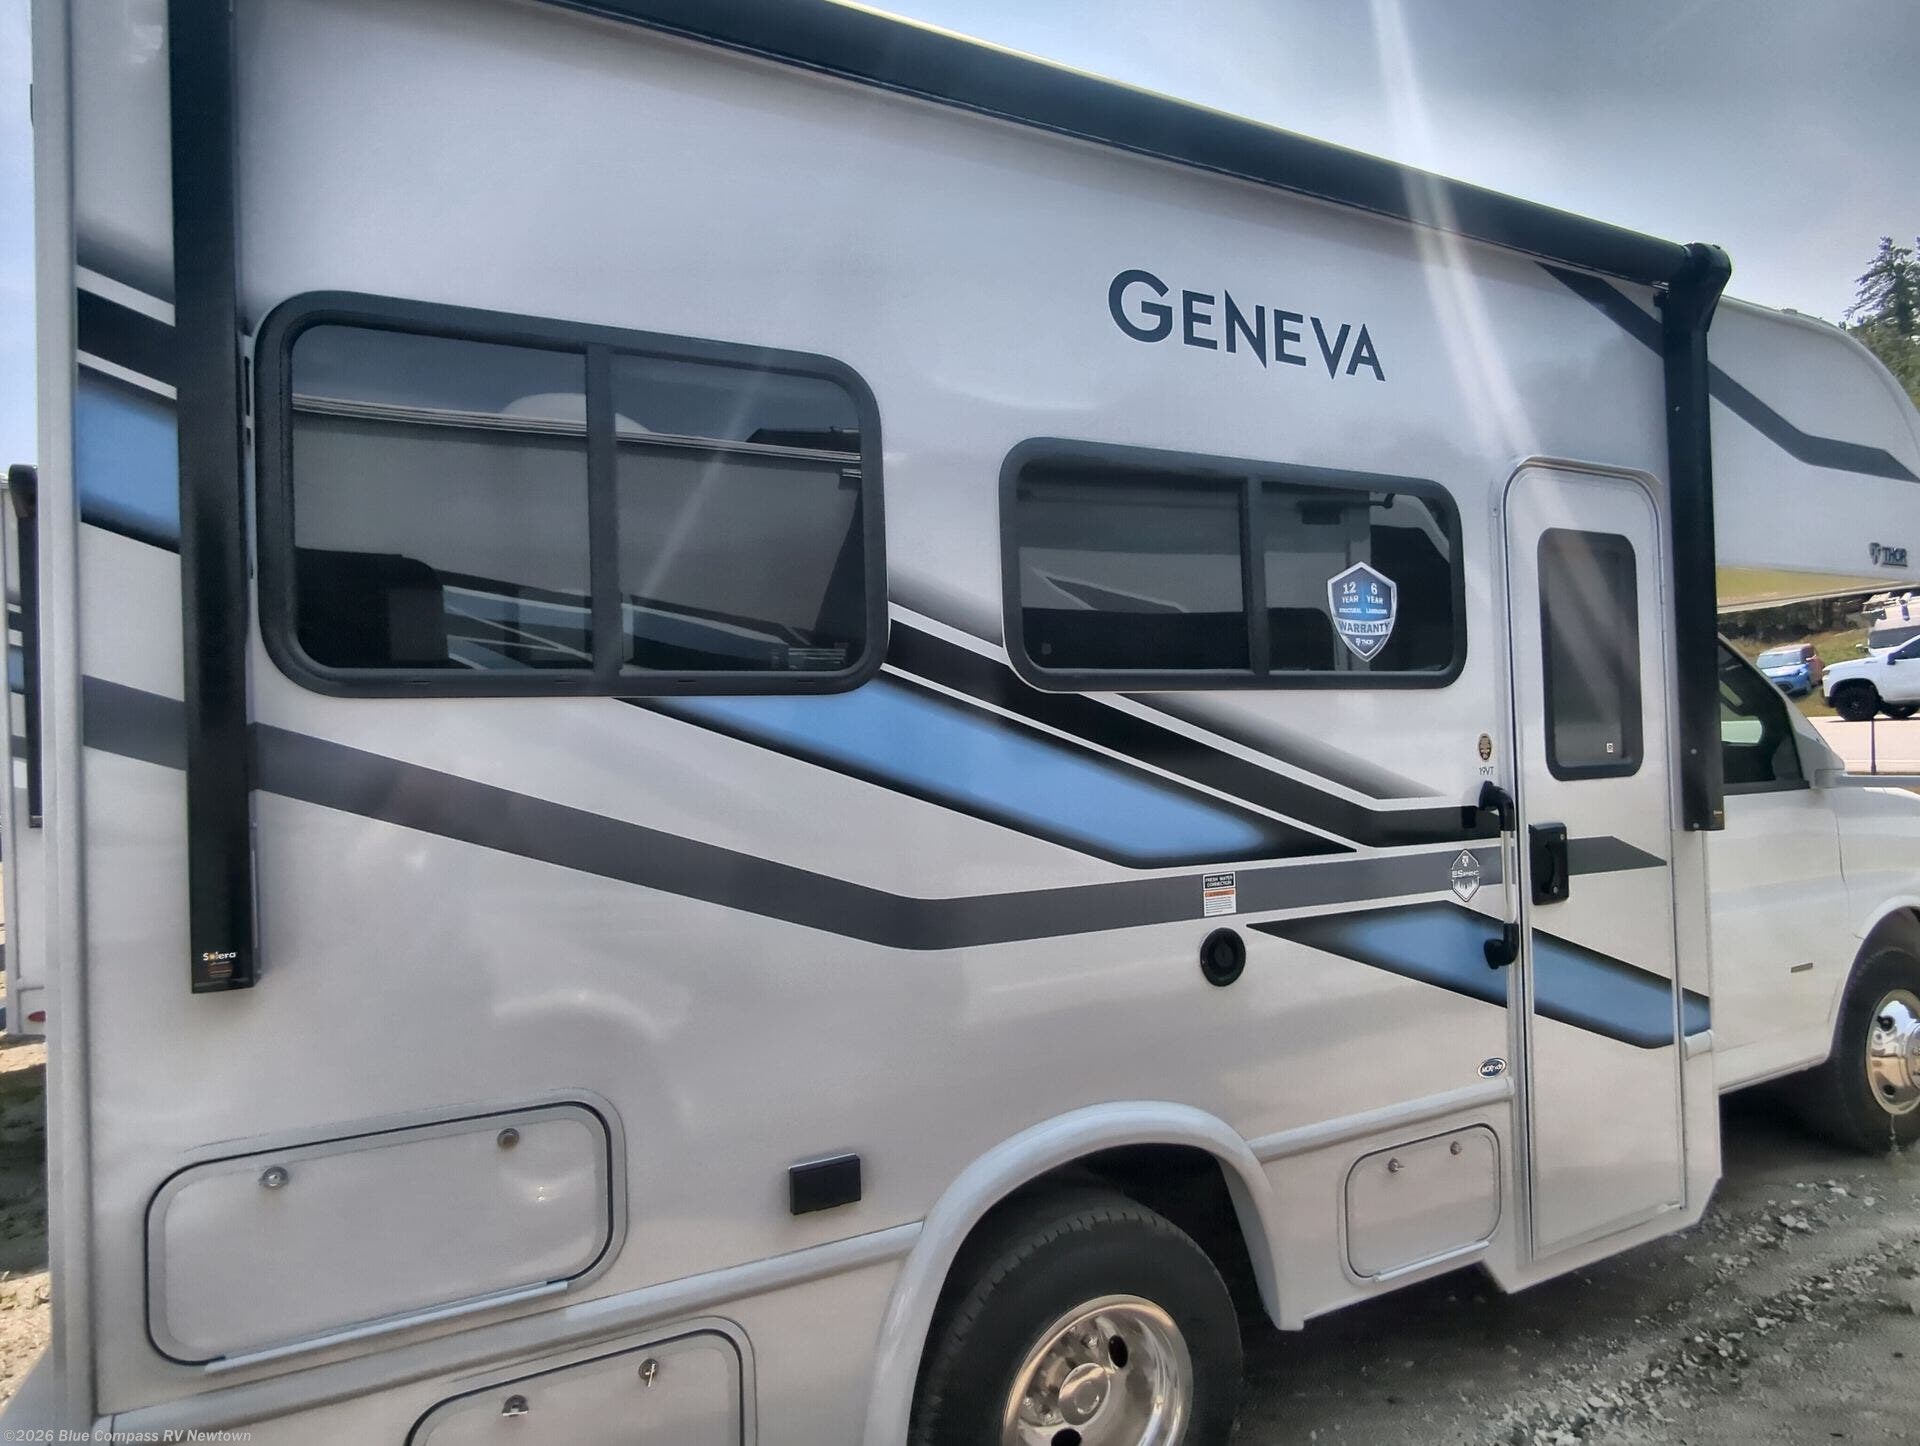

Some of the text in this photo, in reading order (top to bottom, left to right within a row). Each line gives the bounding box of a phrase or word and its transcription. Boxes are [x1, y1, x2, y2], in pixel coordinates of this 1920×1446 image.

[1108, 269, 1386, 382] GENEVA
[1882, 546, 1907, 563] THOR
[1342, 581, 1357, 595] 12
[1370, 582, 1378, 596] 6
[1341, 595, 1359, 604] YEAR
[1366, 595, 1384, 605] YEAR
[1340, 622, 1391, 634] WARRANTY
